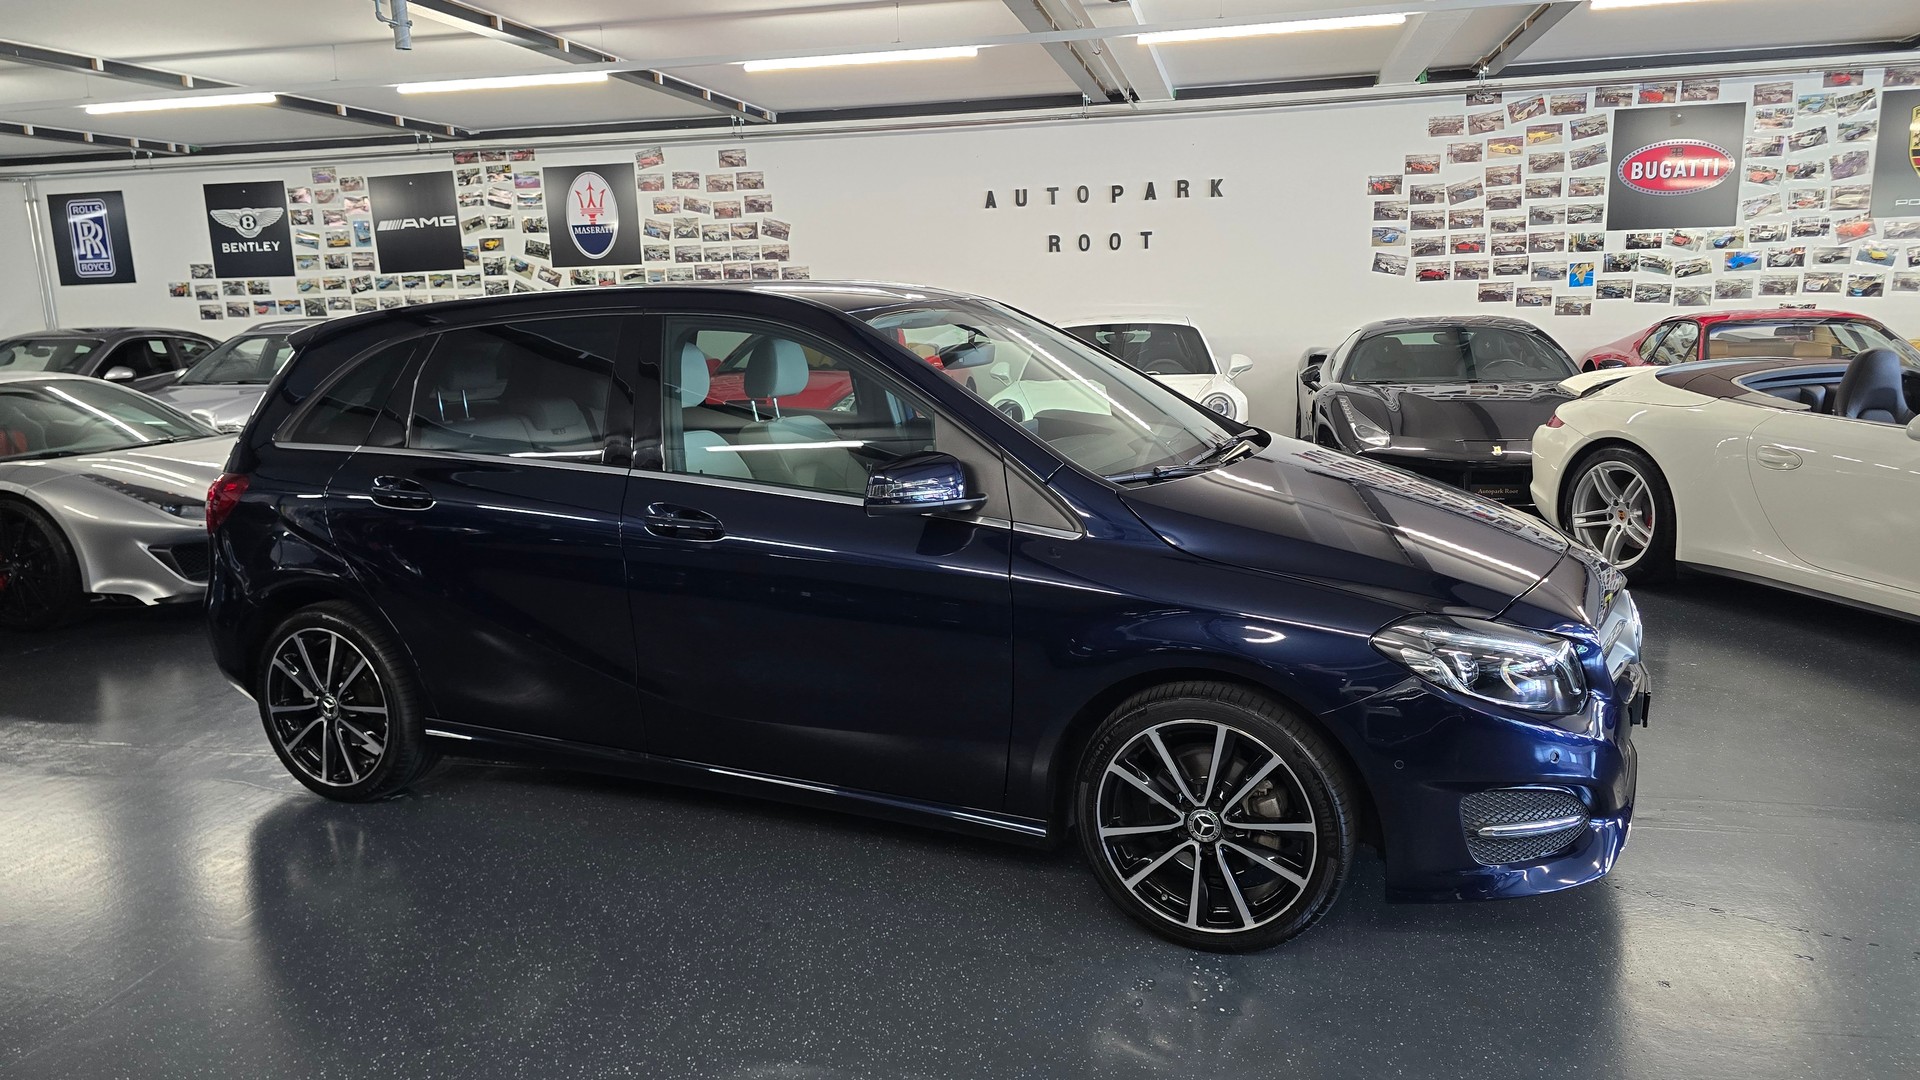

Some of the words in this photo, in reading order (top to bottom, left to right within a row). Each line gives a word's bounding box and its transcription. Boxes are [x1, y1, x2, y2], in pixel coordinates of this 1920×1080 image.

[1631, 158, 1720, 180] BUGATTI
[984, 178, 1224, 209] AUTOPARK
[72, 205, 101, 215] ROLLS
[400, 215, 457, 230] AMG
[221, 240, 280, 253] BENTLEY
[1048, 231, 1153, 253] ROOT
[81, 262, 110, 272] ROYCE
